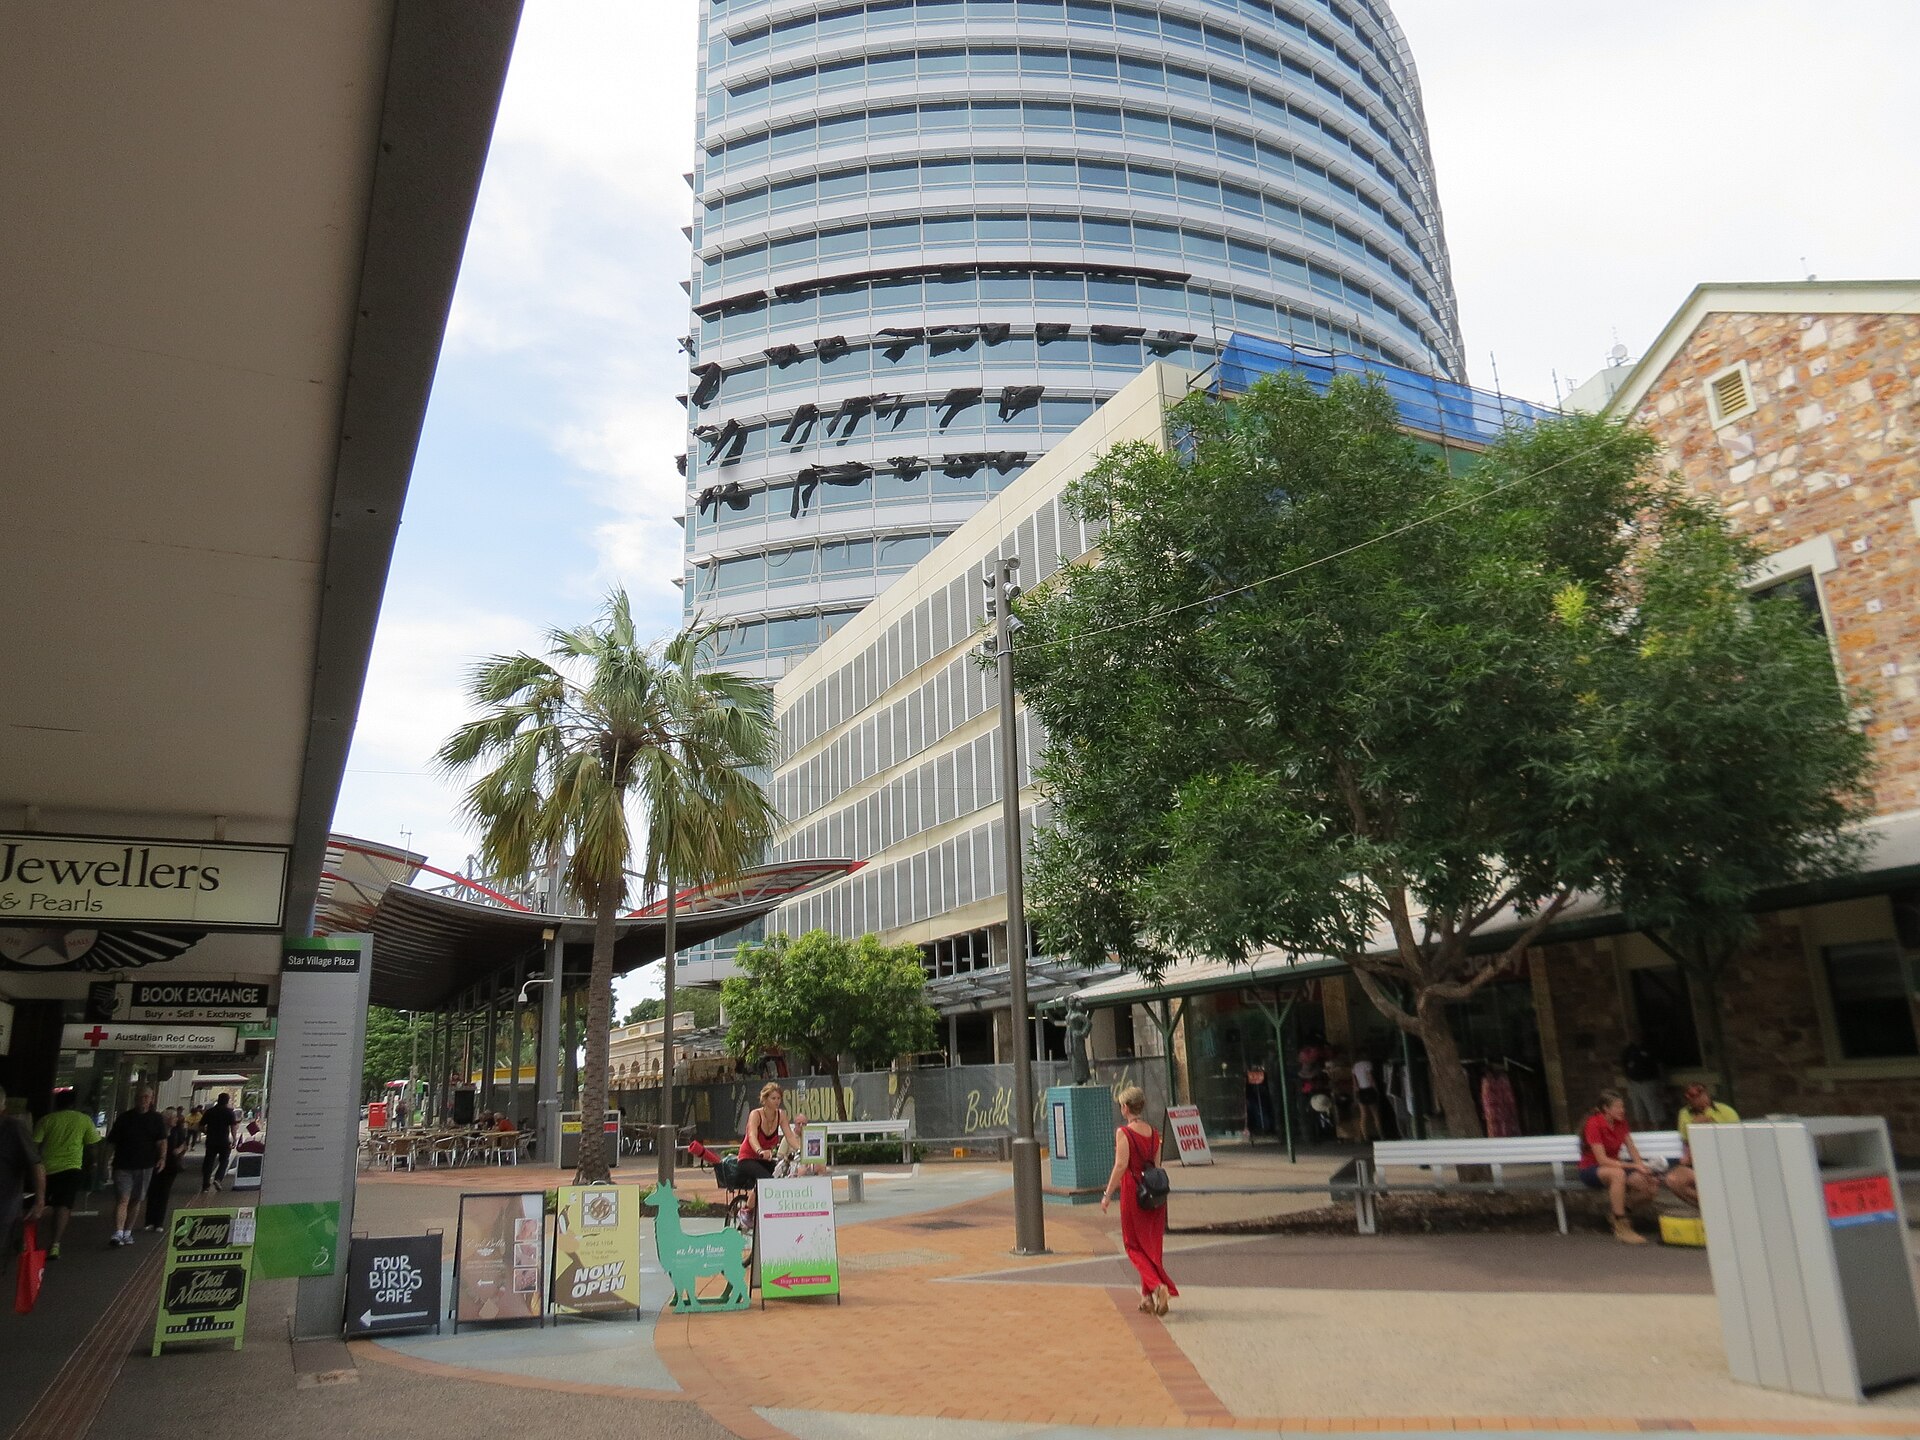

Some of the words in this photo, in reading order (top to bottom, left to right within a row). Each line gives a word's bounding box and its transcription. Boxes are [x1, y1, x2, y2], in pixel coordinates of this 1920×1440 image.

[0, 844, 220, 891] Jewellers
[0, 893, 20, 909] &
[29, 889, 103, 912] Pearls
[288, 955, 304, 965] Star
[306, 955, 332, 967] Village
[334, 956, 355, 966] Plaza
[141, 987, 184, 1003] BOOK
[187, 987, 258, 1004] EXCHANGE
[145, 1010, 163, 1019] Buy
[176, 1010, 194, 1018] Sell
[206, 1010, 252, 1020] Exchange
[115, 1032, 163, 1042] Australian
[166, 1033, 185, 1042] Red
[188, 1034, 216, 1043] Cross
[964, 1086, 1012, 1134] Build
[1177, 1124, 1200, 1137] NOW
[1180, 1137, 1206, 1152] OPEN
[764, 1185, 812, 1199] Damadi
[777, 1199, 827, 1211] Skincare
[374, 1255, 411, 1270] FOUR
[192, 1270, 228, 1289] Thai
[574, 1260, 625, 1283] NOW
[375, 1286, 412, 1303] CAFÉ
[571, 1275, 626, 1299] OPEN
[169, 1285, 238, 1307] Massage
